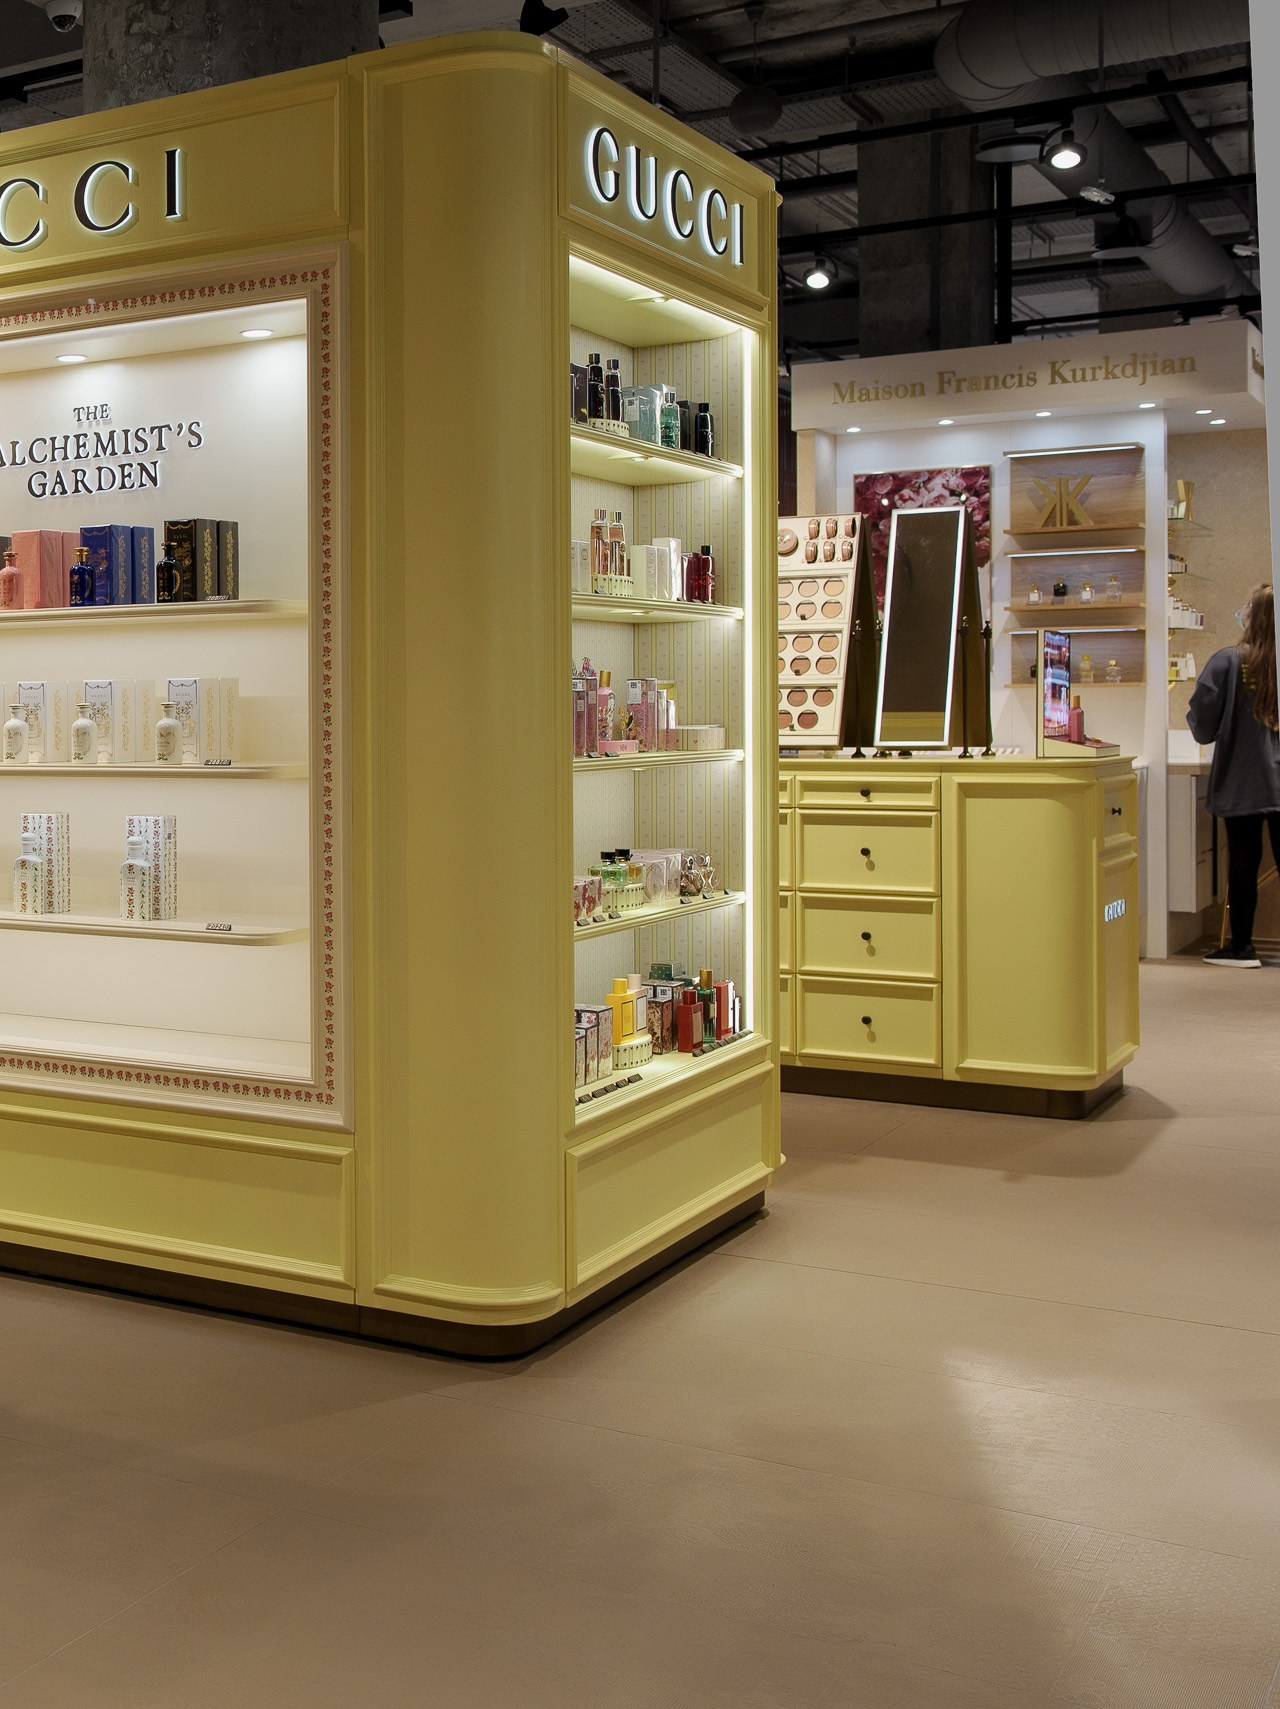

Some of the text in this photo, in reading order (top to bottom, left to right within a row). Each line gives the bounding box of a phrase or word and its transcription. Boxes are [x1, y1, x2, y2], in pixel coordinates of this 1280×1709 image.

[586, 126, 745, 266] GUCCI
[832, 352, 1197, 405] Maison Francis Kurkdjian
[73, 404, 111, 423] THE
[26, 460, 160, 499] GARDEN
